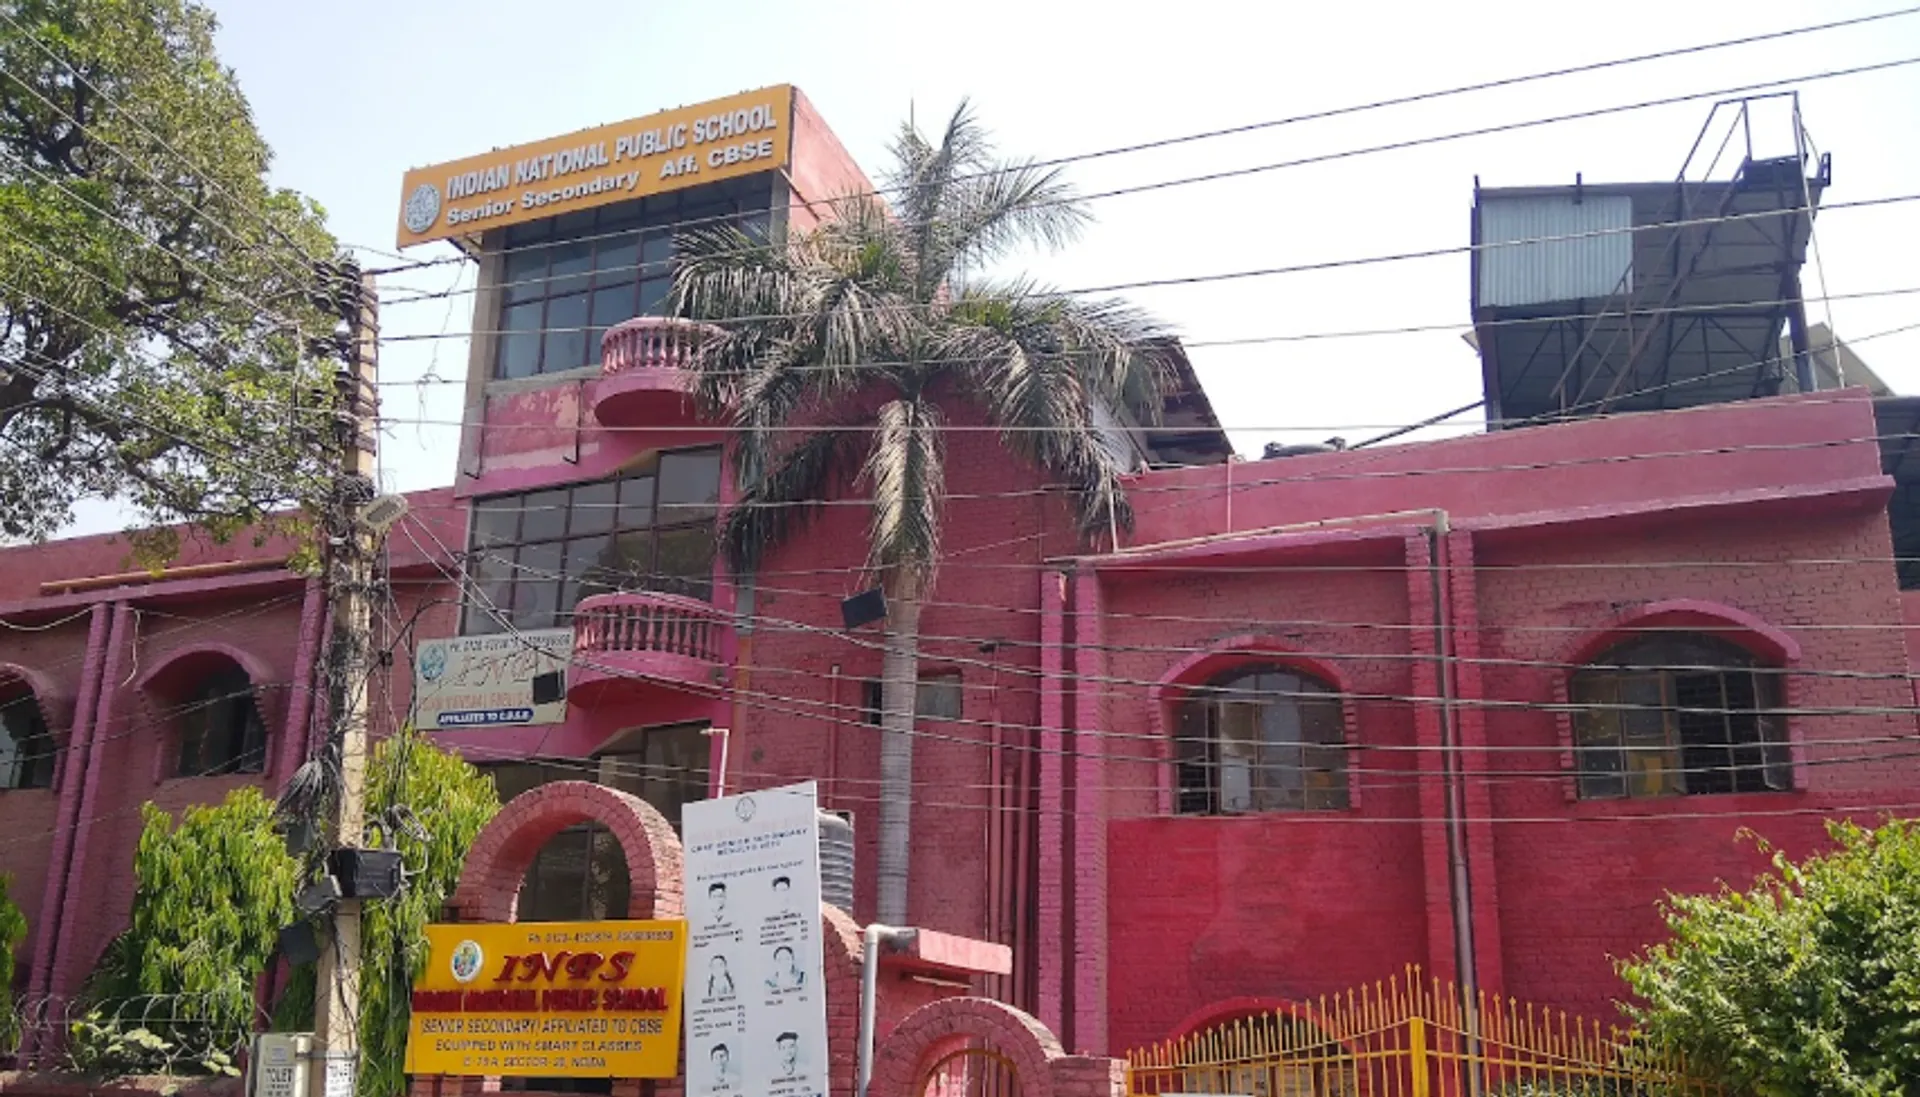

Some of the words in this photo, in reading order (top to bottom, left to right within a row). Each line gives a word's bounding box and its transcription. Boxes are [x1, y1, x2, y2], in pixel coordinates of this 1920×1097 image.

[446, 164, 510, 203] INDIAN
[514, 144, 609, 185] NATIONAL
[614, 122, 686, 162] PUBLIC
[692, 104, 777, 145] SCHOOL
[445, 194, 514, 226] Senior
[520, 169, 640, 209] Secondary
[659, 154, 699, 181] Aff.
[707, 137, 774, 168] CBSE
[493, 951, 637, 982] INPS
[542, 1018, 607, 1034] AFFILIATED
[611, 1018, 627, 1034] TO
[630, 1017, 663, 1034] CBSE
[435, 1040, 495, 1052] EQUIPPED
[499, 1040, 532, 1052] WITH
[535, 1039, 577, 1051] SMART
[582, 1040, 643, 1052] CLASSES
